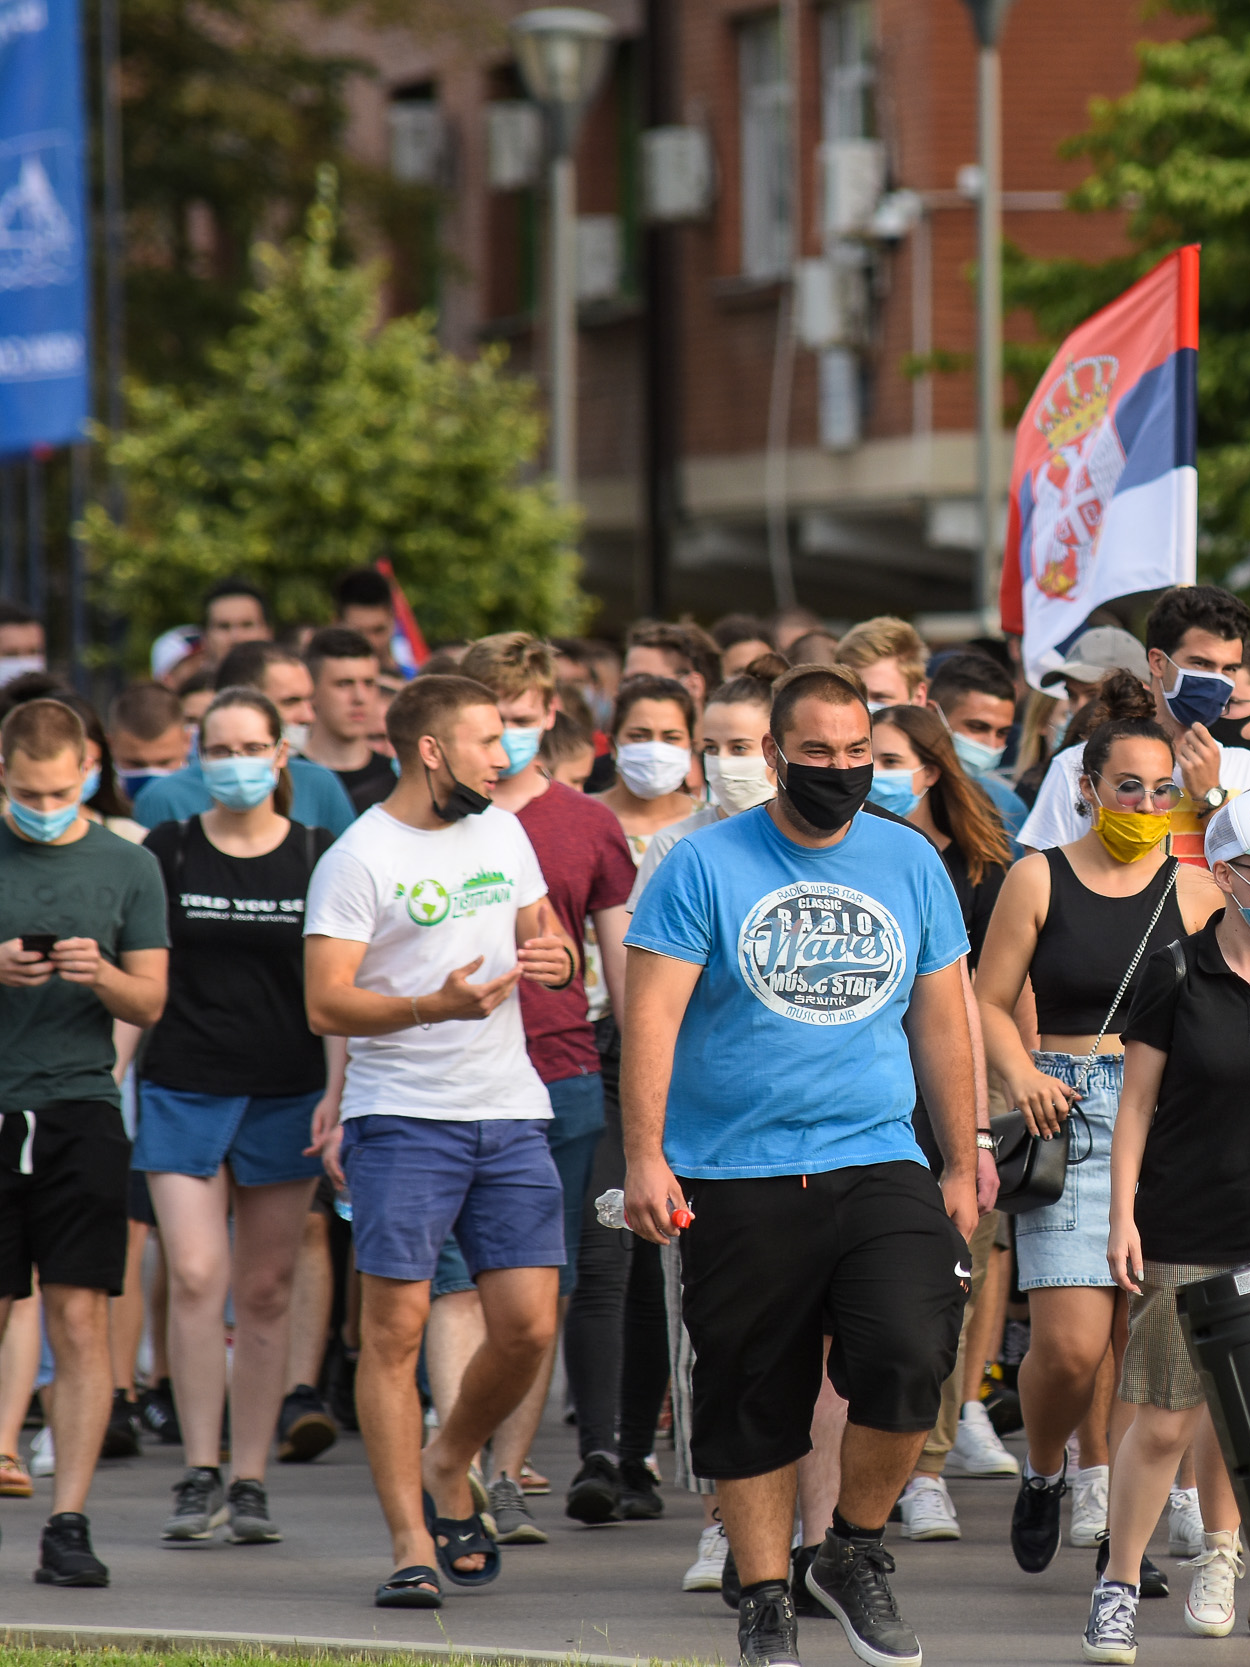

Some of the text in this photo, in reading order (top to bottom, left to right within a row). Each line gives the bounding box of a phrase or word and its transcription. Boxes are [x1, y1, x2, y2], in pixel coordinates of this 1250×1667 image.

[776, 884, 864, 903] RADIO SUPER STAR
[232, 899, 278, 912] YOU
[798, 897, 843, 911] CLASSIC
[776, 908, 873, 935] RADIO
[743, 915, 887, 978] Waves
[832, 975, 877, 997] STAR
[785, 1006, 815, 1021] MUSIC
[839, 1009, 857, 1020] AIR
